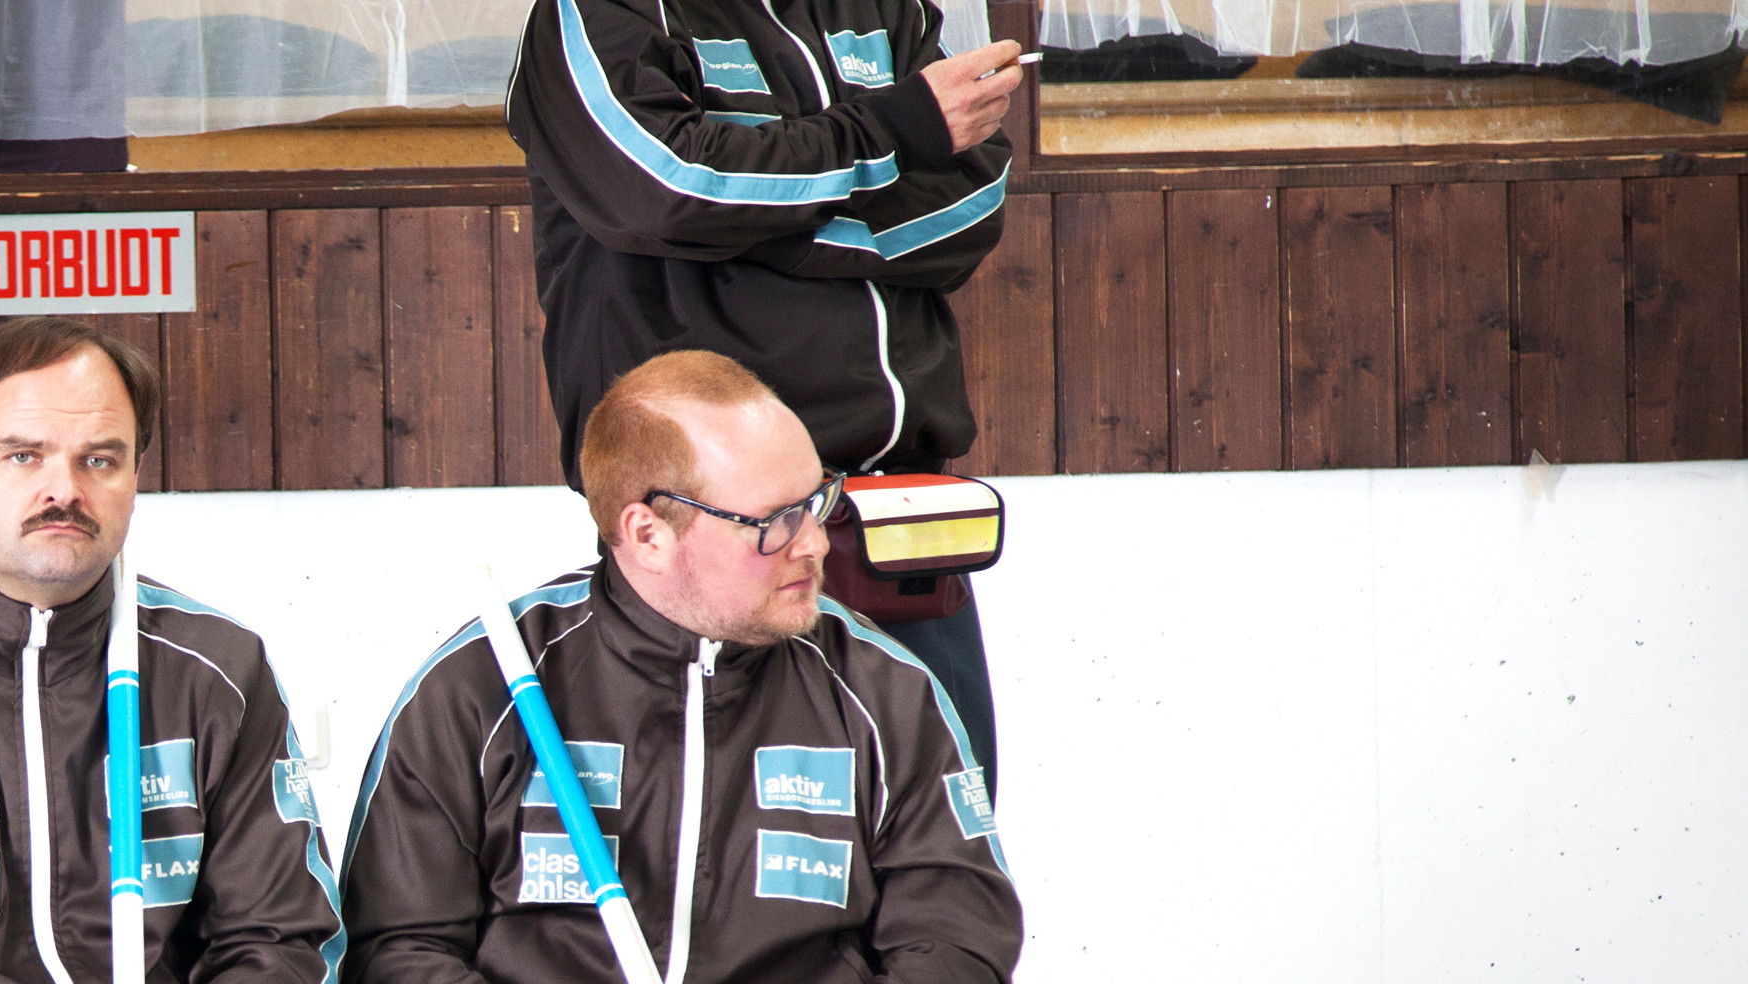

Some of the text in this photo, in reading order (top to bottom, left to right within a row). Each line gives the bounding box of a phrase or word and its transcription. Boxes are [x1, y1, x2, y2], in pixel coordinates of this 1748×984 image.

[840, 53, 879, 75] aktiv
[140, 774, 170, 795] tiv
[764, 773, 825, 798] aktiv
[141, 860, 200, 880] FLAX
[524, 847, 580, 874] clas
[786, 856, 843, 879] FLAX
[523, 873, 595, 900] ohlso
